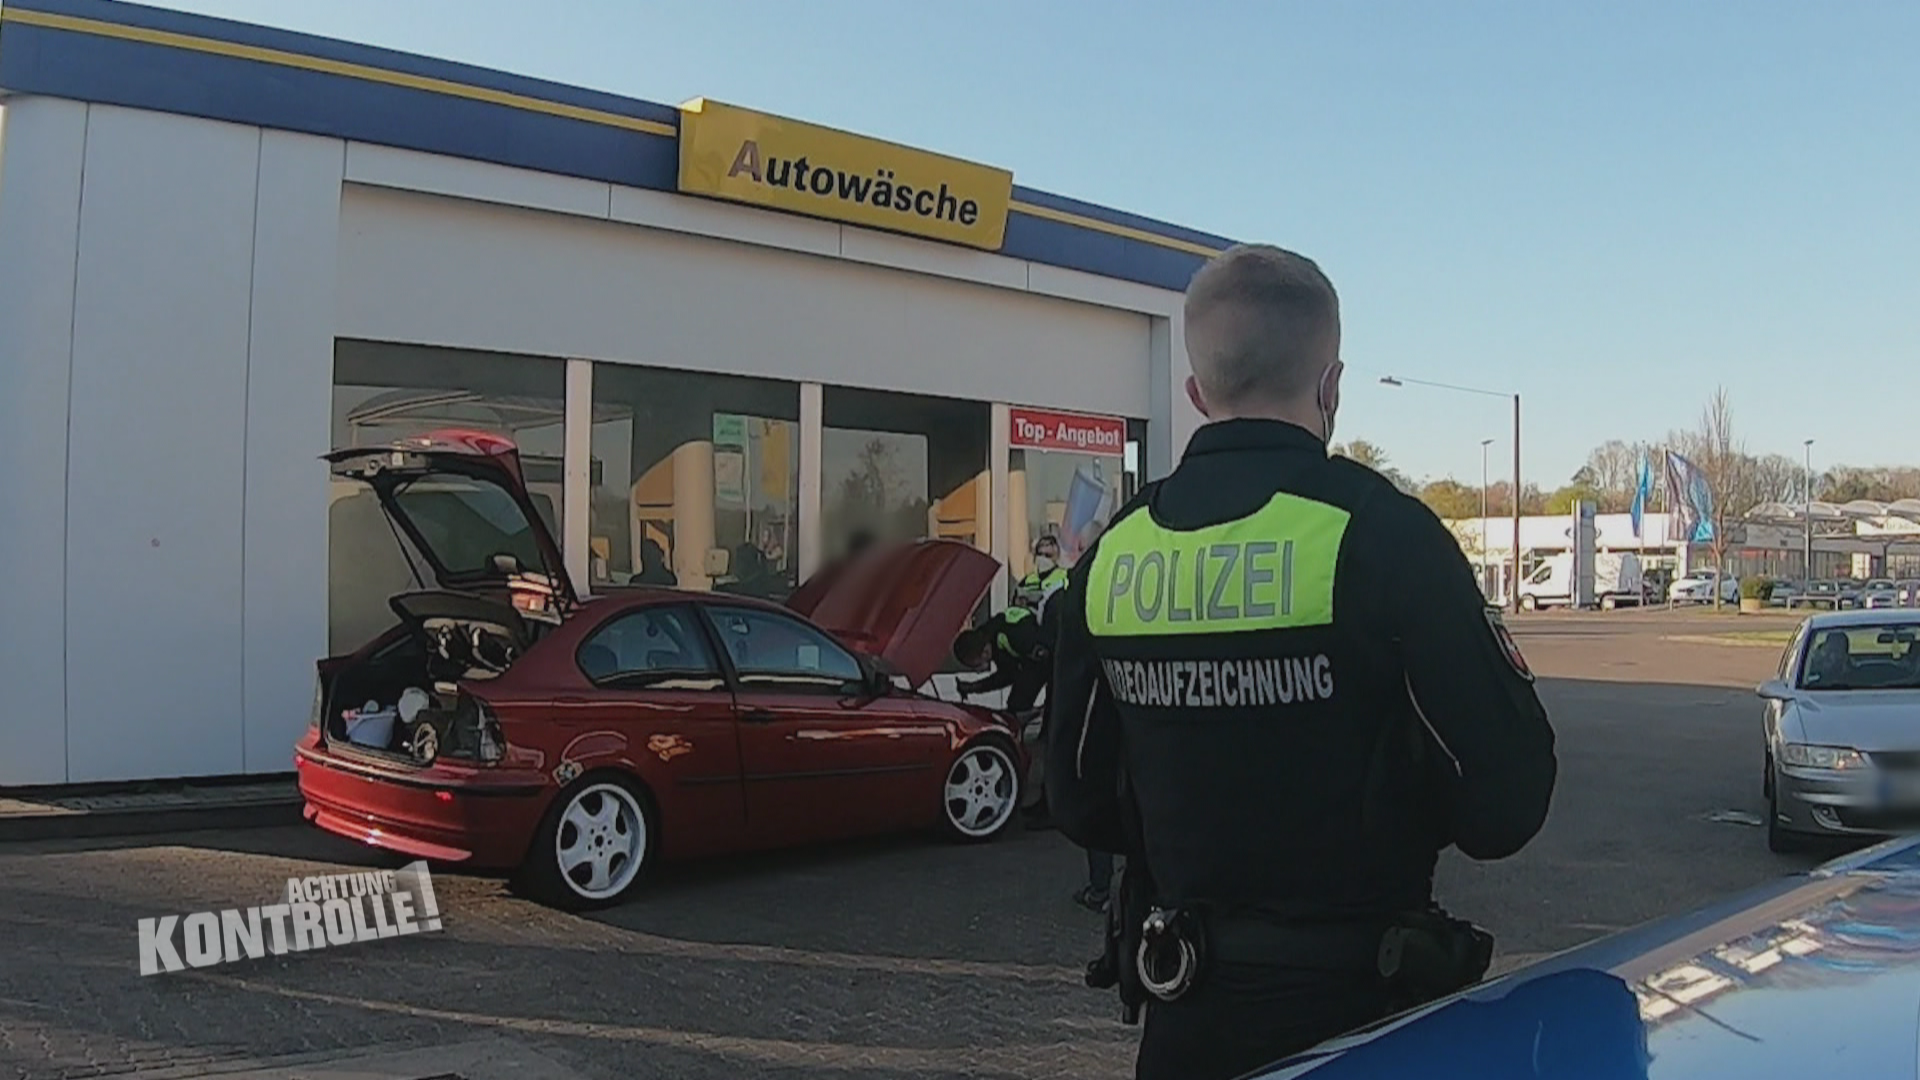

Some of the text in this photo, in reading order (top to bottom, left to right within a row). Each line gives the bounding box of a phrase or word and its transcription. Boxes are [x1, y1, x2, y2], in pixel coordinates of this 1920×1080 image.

[727, 140, 979, 226] Autowäsche
[1015, 418, 1045, 443] Top
[1056, 422, 1120, 448] Angebot
[1107, 540, 1294, 624] POLIZEI
